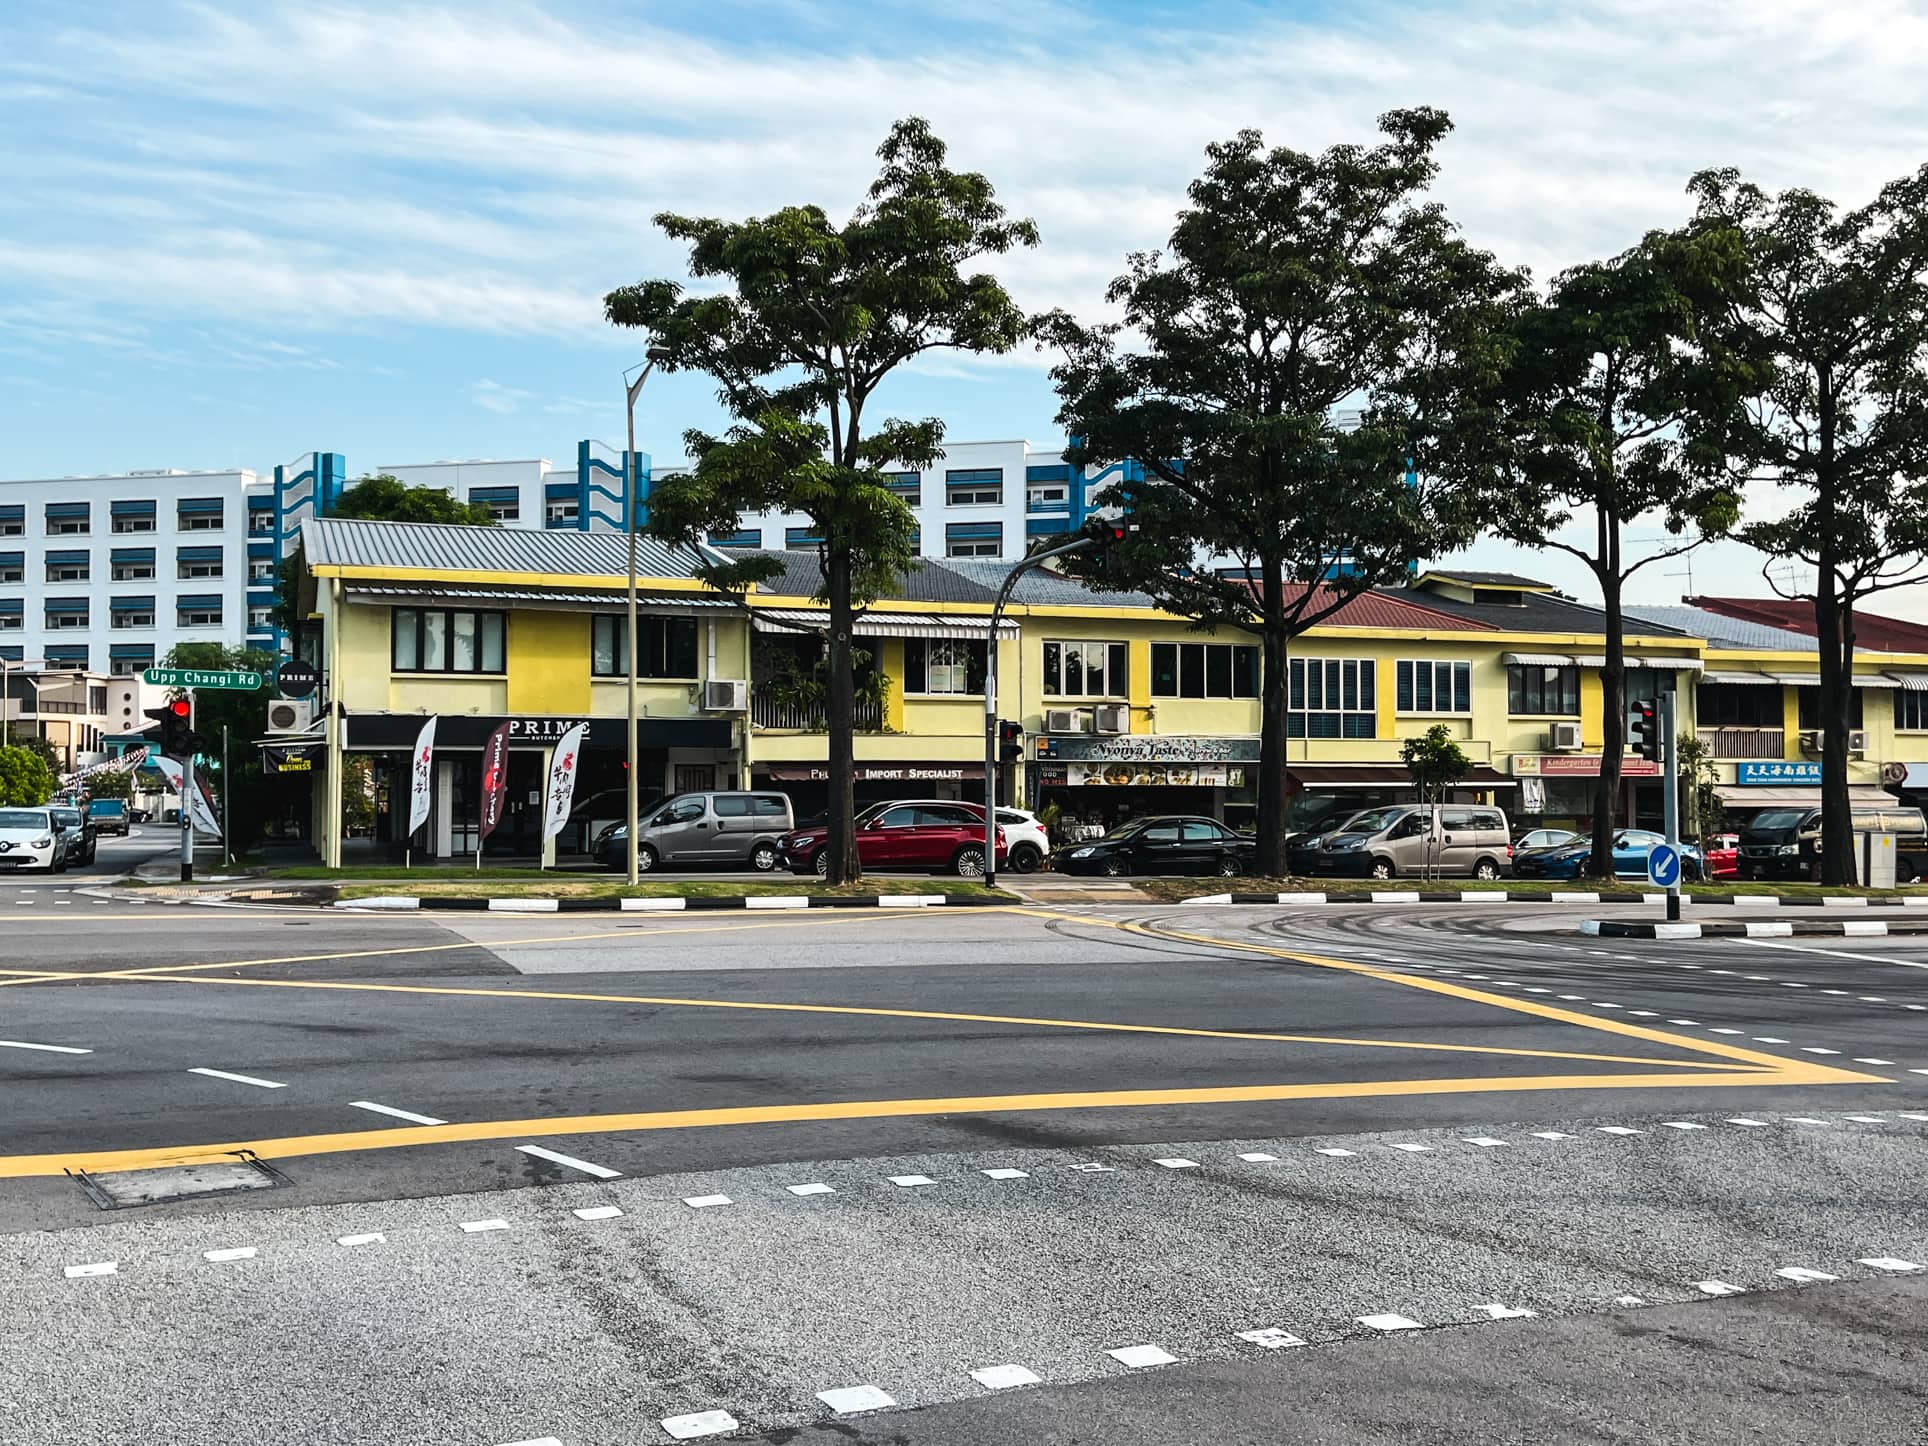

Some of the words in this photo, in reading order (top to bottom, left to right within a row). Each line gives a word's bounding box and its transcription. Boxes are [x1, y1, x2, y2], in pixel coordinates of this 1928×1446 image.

[150, 670, 177, 684] Upp
[184, 672, 231, 687] Changi
[238, 674, 255, 685] Rd
[509, 720, 591, 734] PRIME
[493, 733, 503, 769] Prime
[1090, 742, 1145, 760] Nyonya
[1148, 741, 1180, 756] Taste
[865, 769, 903, 779] IMPORT
[908, 768, 964, 779] SPECIALIST
